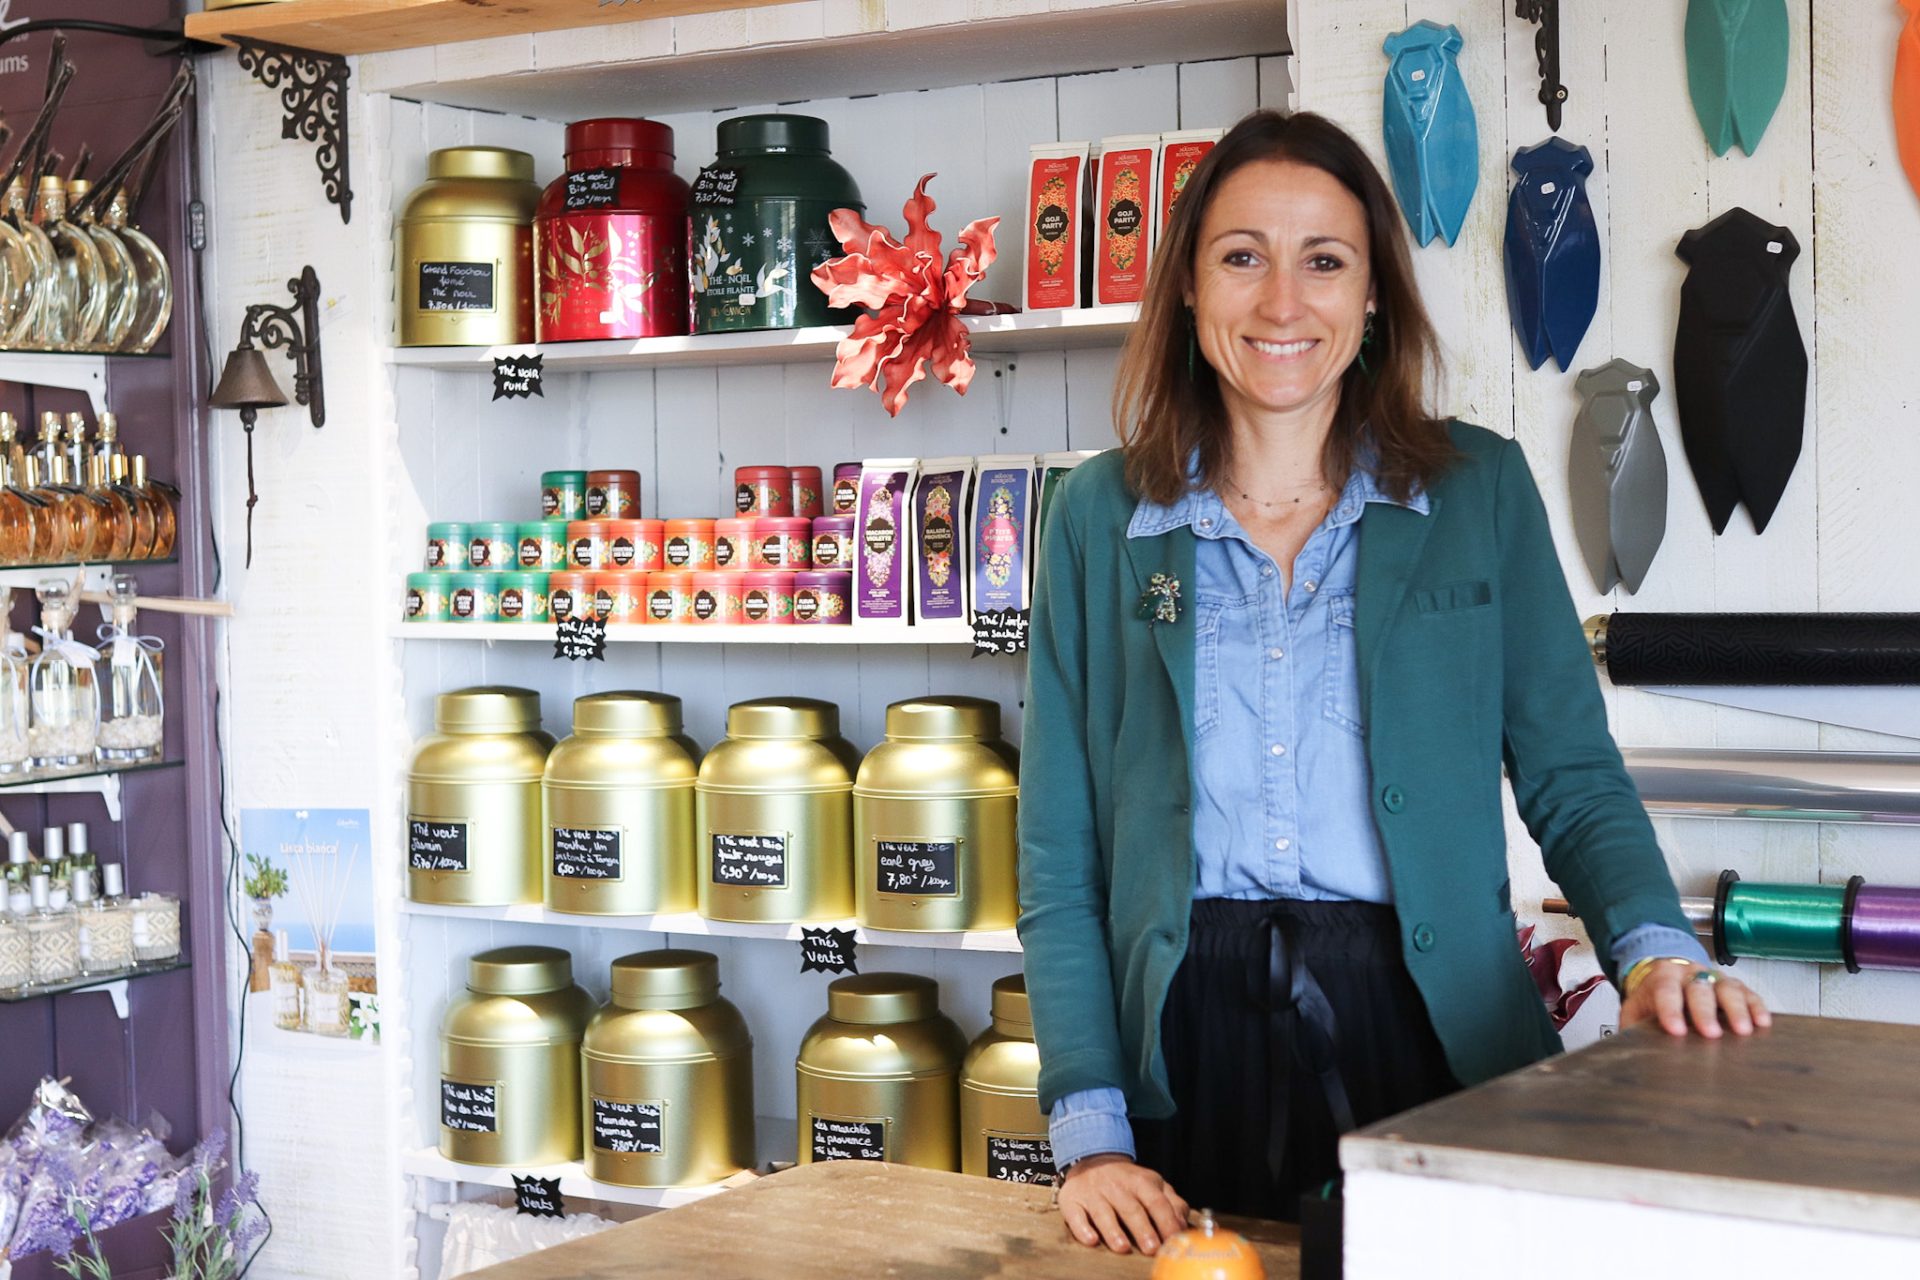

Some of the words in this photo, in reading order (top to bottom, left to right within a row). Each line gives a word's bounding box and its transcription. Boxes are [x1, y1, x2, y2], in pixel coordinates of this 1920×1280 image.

[569, 172, 586, 183] Thé
[702, 169, 718, 179] Thé
[568, 183, 588, 195] Bio
[697, 180, 714, 190] Bio
[422, 264, 448, 275] Grand
[726, 285, 755, 295] FILANTE
[503, 378, 530, 391] FUMÉ
[977, 630, 989, 638] en
[413, 822, 429, 837] Thé
[432, 825, 460, 839] vert
[572, 830, 591, 840] vert
[927, 843, 949, 852] Bio
[880, 854, 904, 868] earl
[908, 858, 936, 872] grey
[807, 934, 839, 949] Thés
[806, 950, 845, 965] Verts
[815, 1132, 826, 1144] de
[1039, 1141, 1052, 1151] Bi
[861, 1148, 882, 1158] Bio
[1029, 1152, 1054, 1164] Blan
[520, 1182, 548, 1196] Thés
